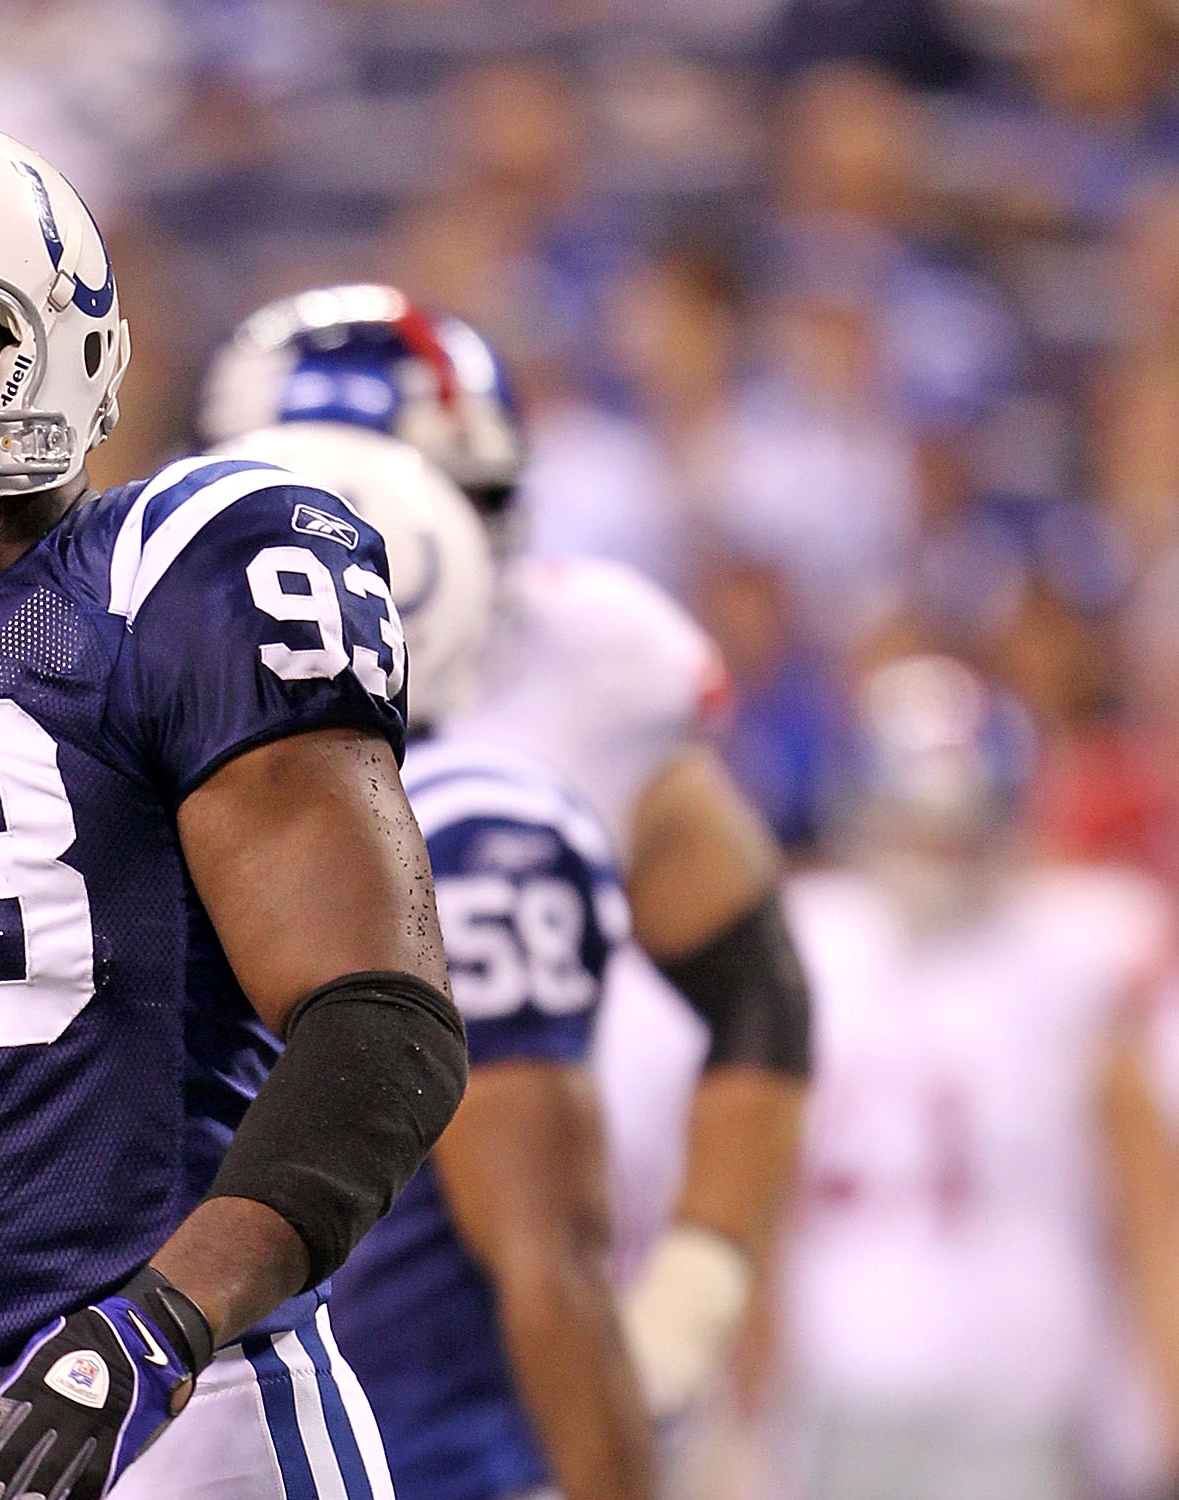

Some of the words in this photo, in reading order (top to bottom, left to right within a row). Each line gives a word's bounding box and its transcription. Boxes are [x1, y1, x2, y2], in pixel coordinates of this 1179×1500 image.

[1, 354, 33, 407] ddell
[245, 546, 405, 702] 93
[435, 874, 597, 1019] 58
